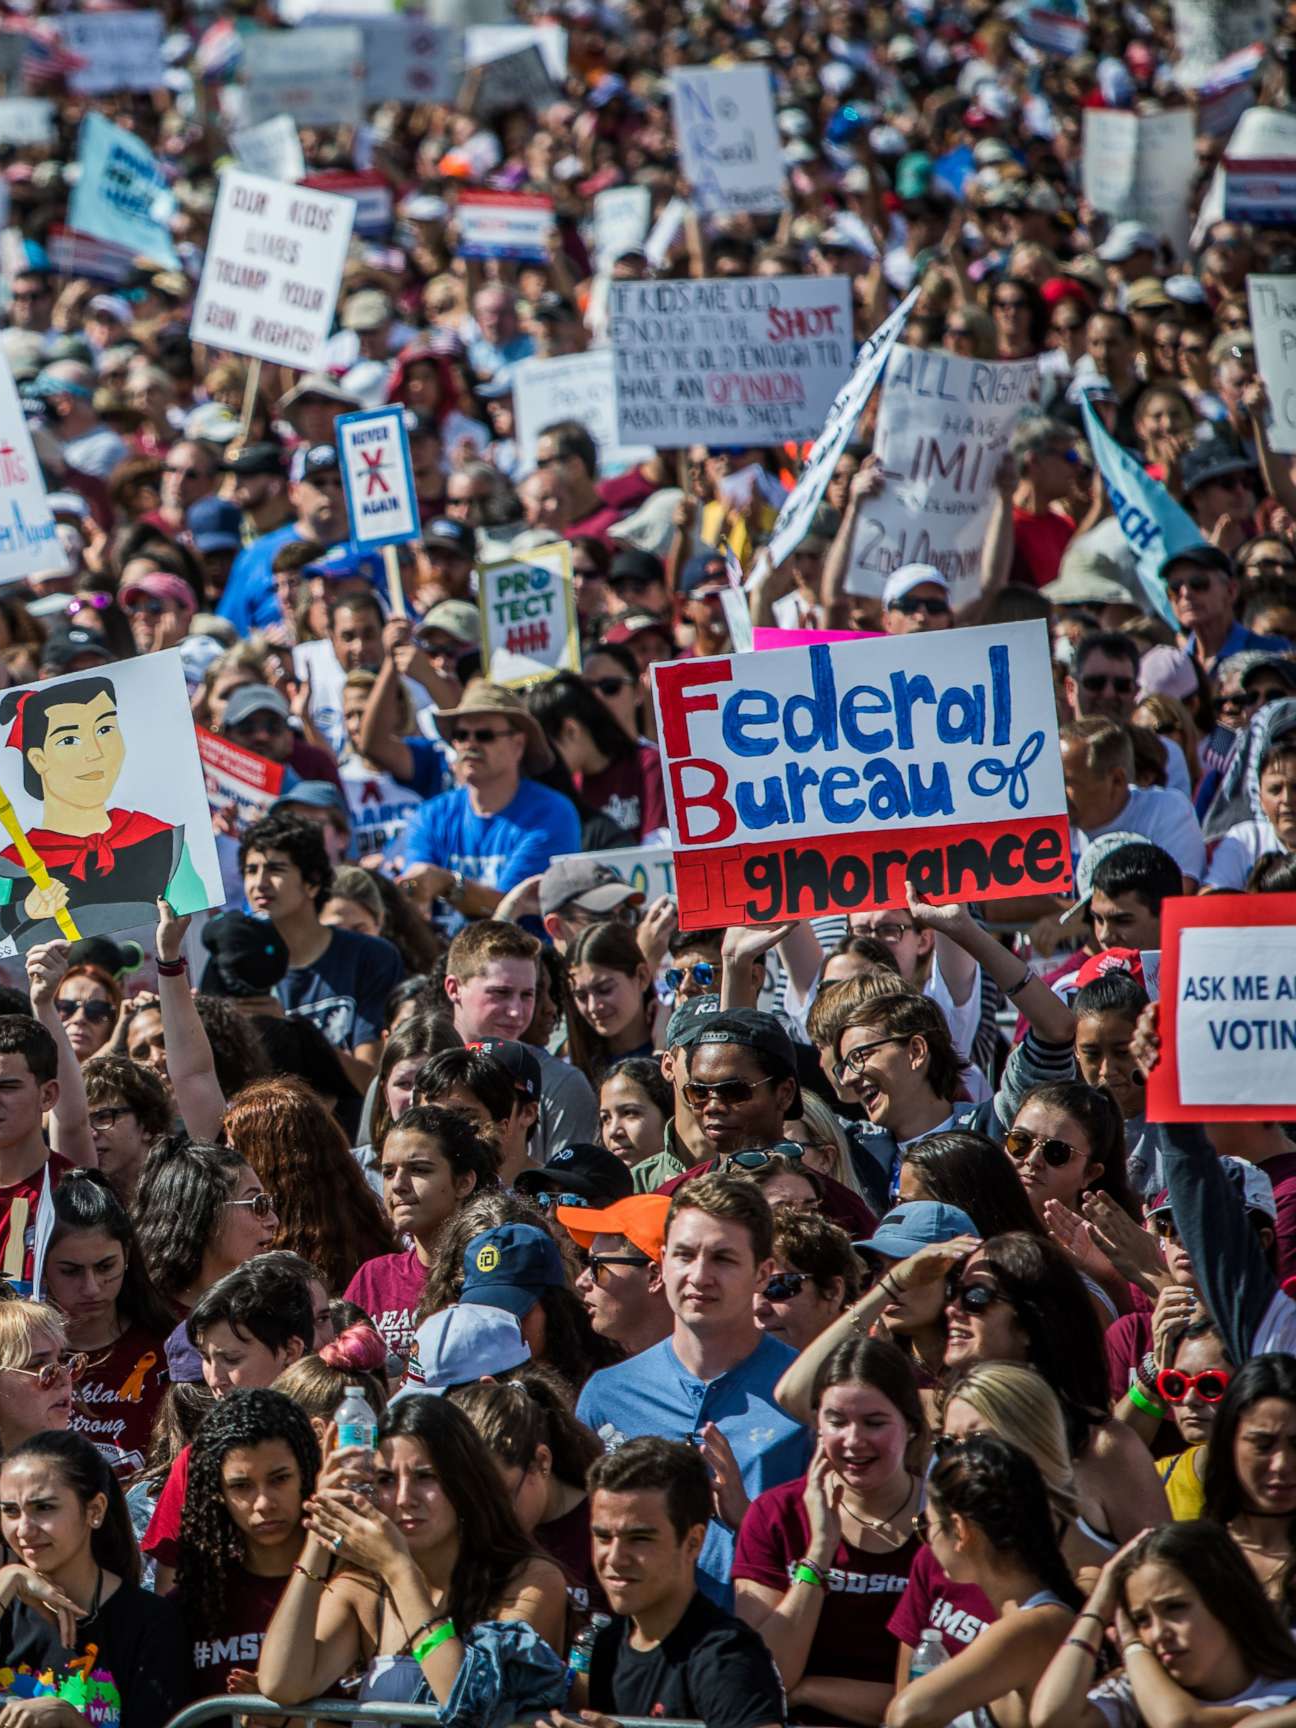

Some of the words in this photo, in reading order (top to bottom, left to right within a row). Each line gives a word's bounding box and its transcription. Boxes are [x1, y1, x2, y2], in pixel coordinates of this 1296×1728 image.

[232, 185, 268, 217] OUR
[216, 258, 267, 292] TRUMP
[282, 280, 335, 312] YOUR
[639, 281, 692, 316] KIDS
[739, 281, 782, 310] OLD
[699, 344, 737, 370] OLD
[738, 341, 812, 369] ENOUGH
[814, 340, 843, 369] TO
[619, 377, 665, 401] HAVE
[673, 376, 704, 400] AN
[707, 371, 805, 403] OPINION
[890, 352, 958, 402] ALL
[351, 426, 390, 446] NEVER
[362, 496, 401, 515] AGAIN
[655, 644, 1010, 758] Federal
[669, 757, 955, 845] Bureau
[967, 731, 1045, 810] of
[1184, 976, 1226, 1001] ASK
[1233, 976, 1268, 1001] ME
